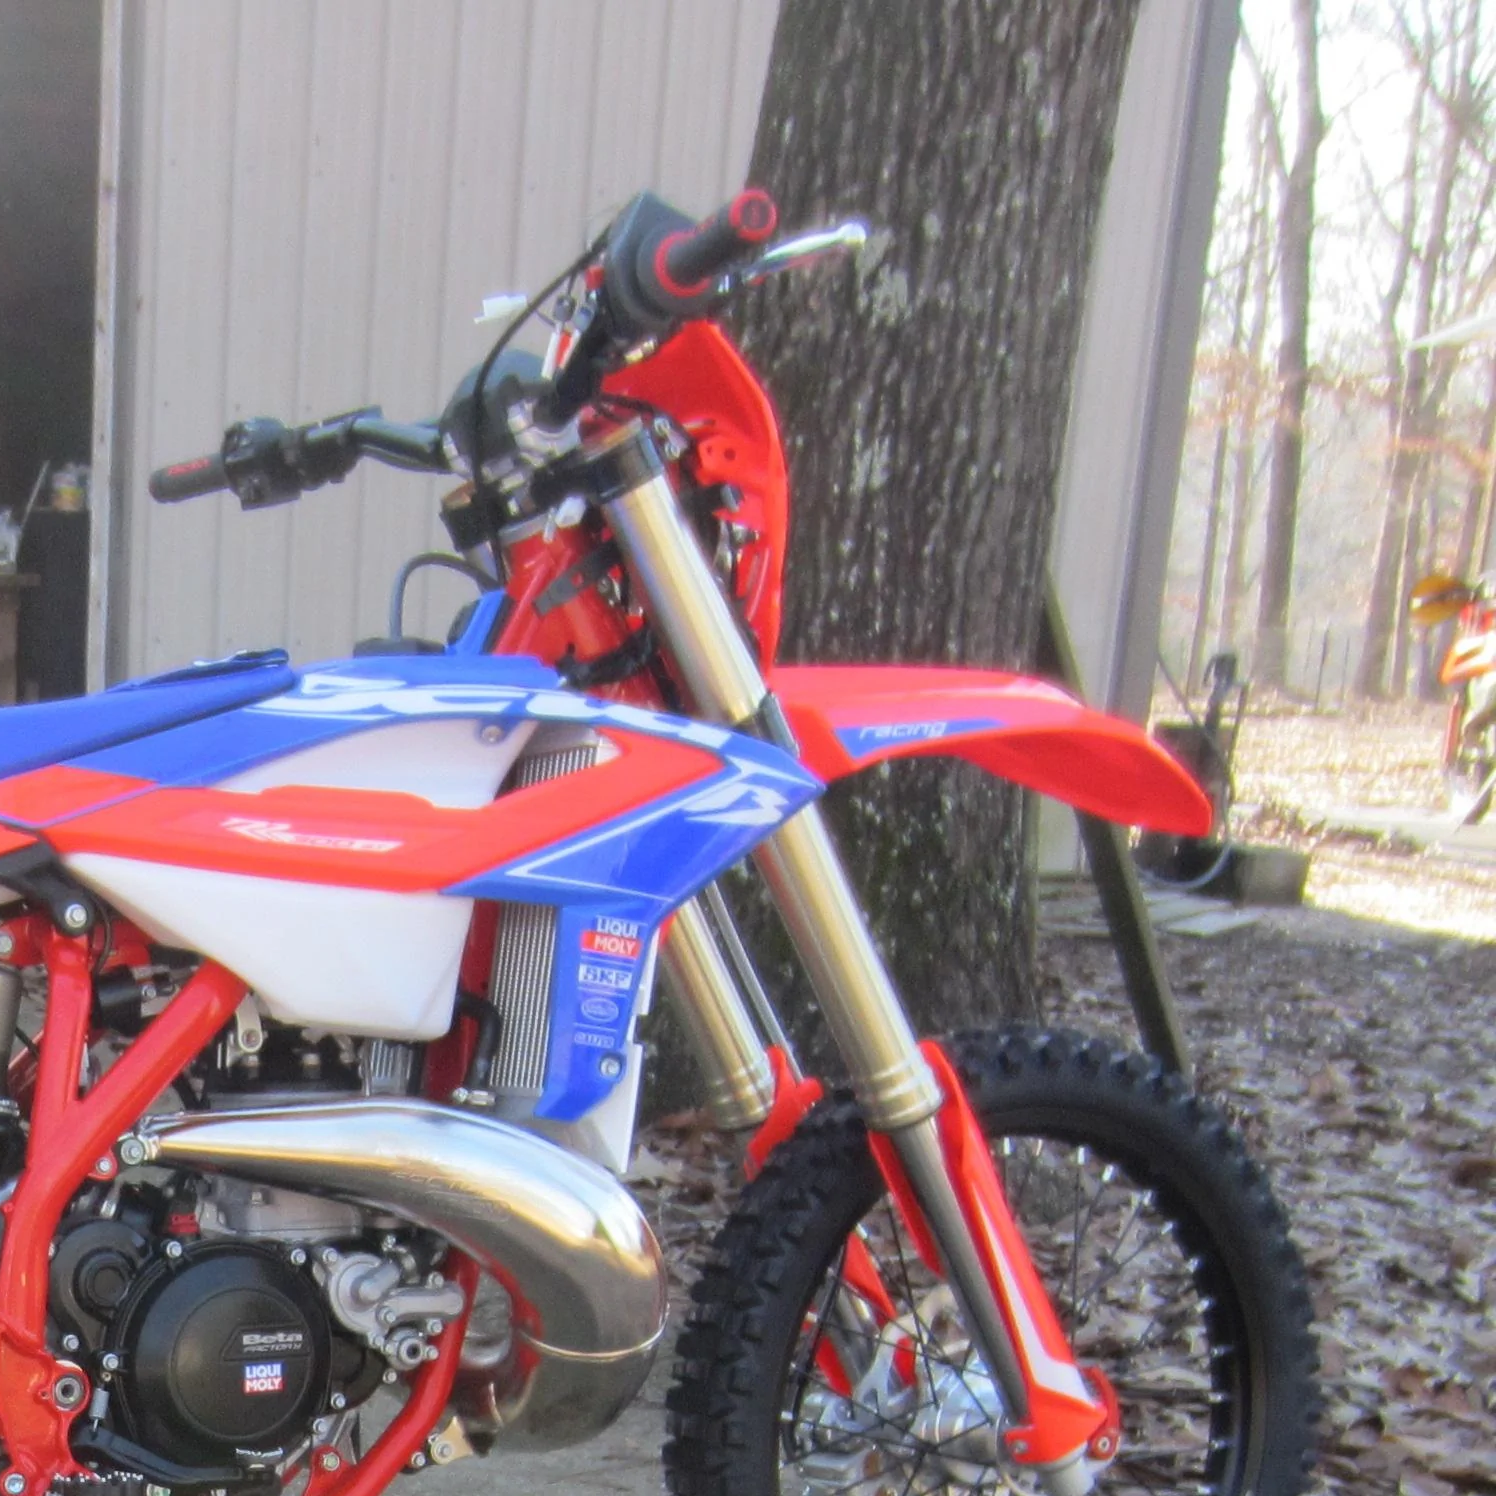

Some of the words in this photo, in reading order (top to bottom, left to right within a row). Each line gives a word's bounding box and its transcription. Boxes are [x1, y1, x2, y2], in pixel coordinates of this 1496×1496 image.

[859, 720, 947, 741] racing
[596, 916, 639, 938] LIQUI
[594, 934, 637, 956] MOLY
[583, 966, 629, 987] SKF
[243, 1332, 303, 1345] Beta
[245, 1363, 282, 1379] LIQUI
[245, 1376, 283, 1393] MOLY
